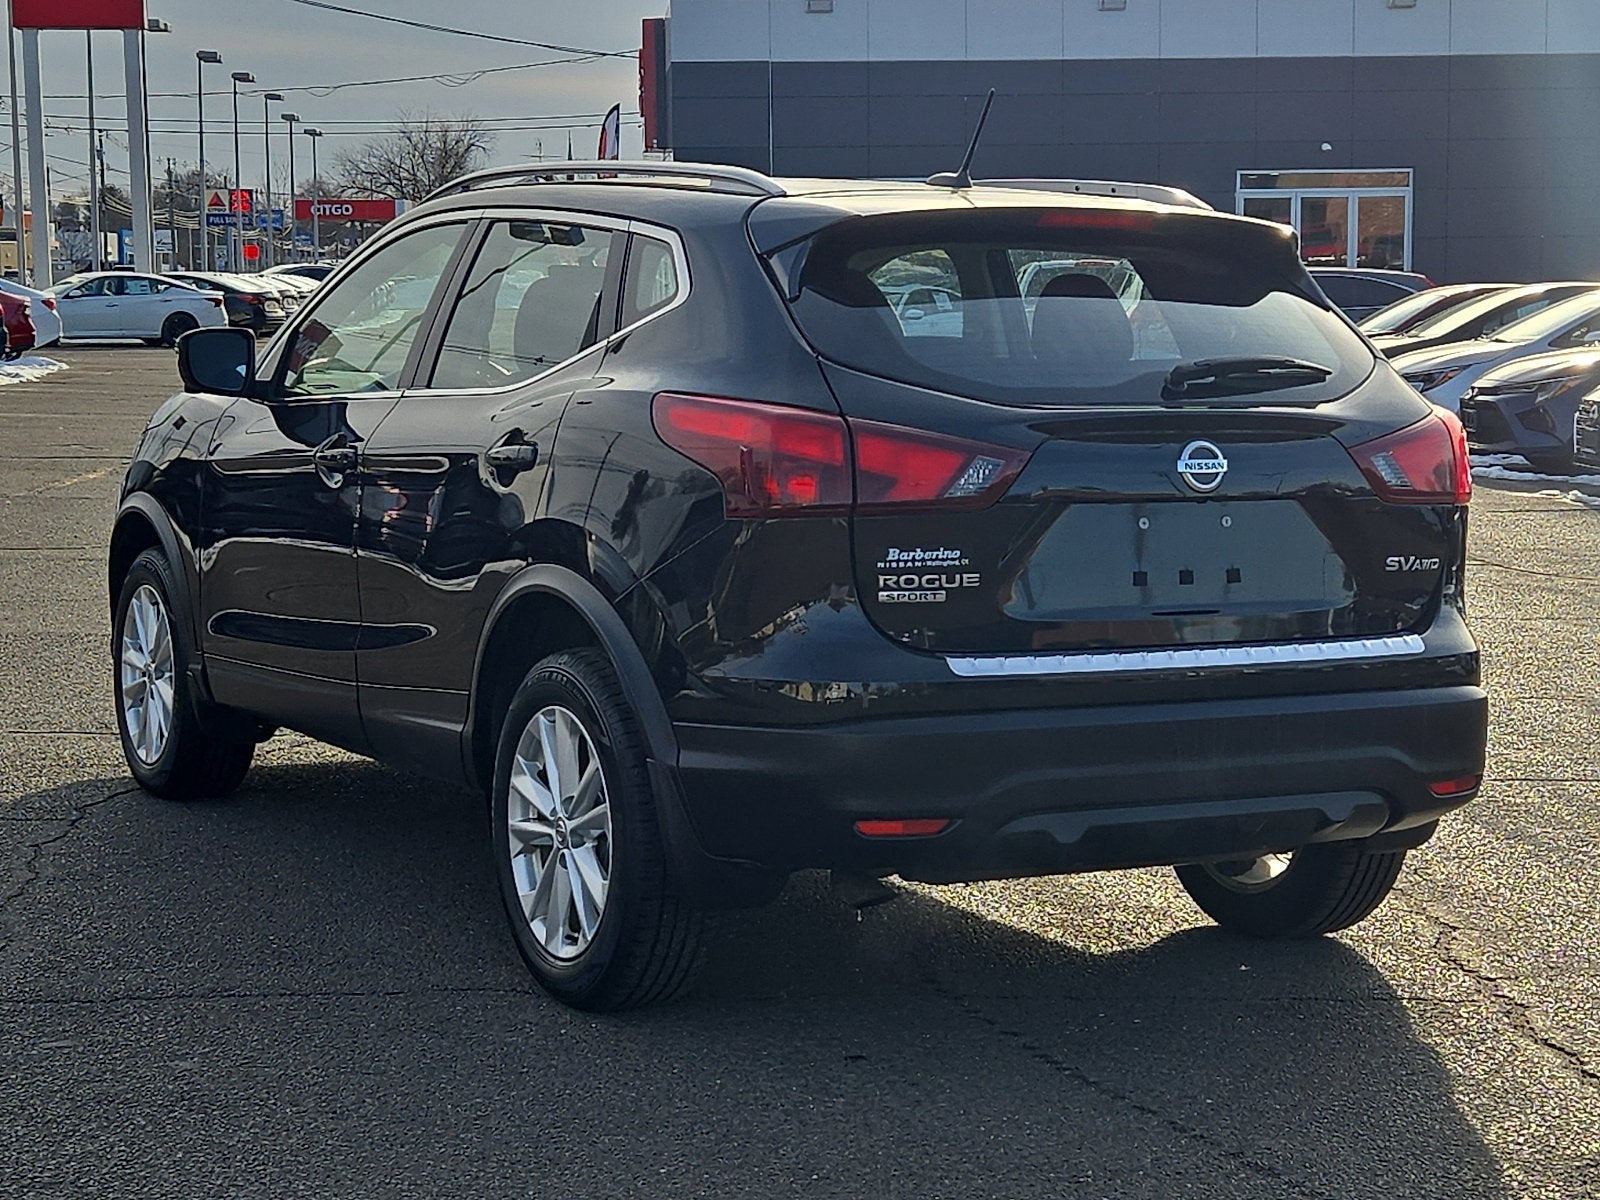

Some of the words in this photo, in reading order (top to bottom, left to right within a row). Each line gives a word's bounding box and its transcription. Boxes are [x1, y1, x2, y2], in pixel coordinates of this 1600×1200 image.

[310, 203, 353, 216] CITGO
[1184, 462, 1225, 471] NISSAN
[1385, 555, 1415, 571] SV
[878, 573, 981, 589] ROGUE
[885, 593, 944, 601] SPORT
